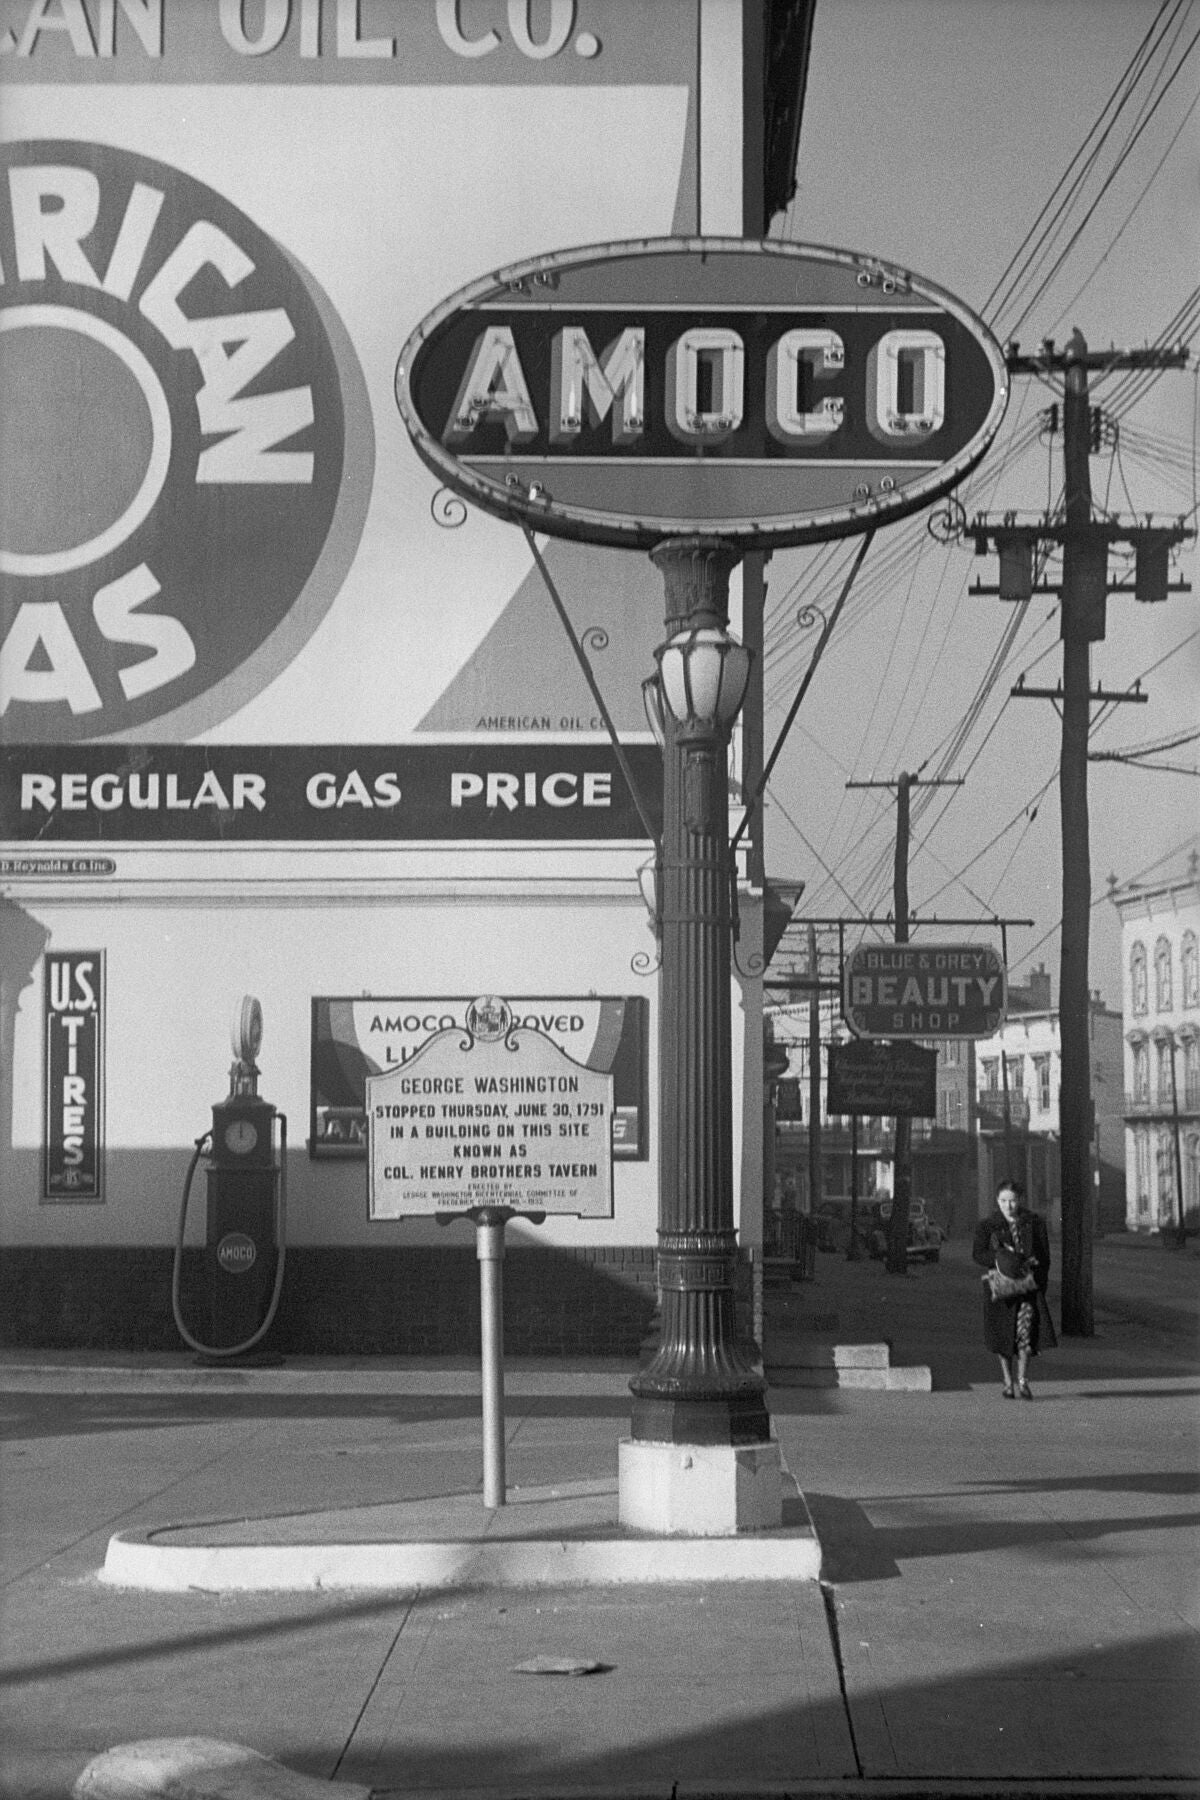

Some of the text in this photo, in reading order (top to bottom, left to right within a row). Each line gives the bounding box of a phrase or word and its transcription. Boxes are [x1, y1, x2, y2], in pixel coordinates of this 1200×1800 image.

[0, 0, 602, 58] AN OIL CO.
[0, 165, 315, 483] RICAN
[443, 325, 946, 447] AMOCO
[475, 716, 551, 729] AMERICAN
[559, 716, 584, 730] OIL
[20, 769, 612, 812] REGULAR GAS PRICE
[14, 860, 68, 873] Reynolds
[867, 953, 984, 969] BLUE & GREY
[50, 961, 97, 1011] U.S.
[852, 976, 999, 1006] BEAUTY
[369, 1015, 585, 1032] AMOCO ROVED
[893, 1012, 960, 1029] SHOP
[61, 1016, 88, 1165] TIRES
[401, 1076, 579, 1094] GEORGE WASHINGTON
[375, 1103, 605, 1118] STOPPED THURSDAY, JUNE 30, 1791
[390, 1123, 590, 1138] IN A BUILDING ON THIS SITE
[453, 1144, 528, 1158] KNOWN AS
[384, 1164, 598, 1180] COL. HENRY BROTHERS TAVERN
[432, 1191, 473, 1199] WASHINGTON
[475, 1190, 522, 1198] BICENTENNIAL
[526, 1189, 566, 1197] COMMITTEE
[569, 1189, 578, 1197] OF
[220, 1246, 253, 1260] AMOCO
